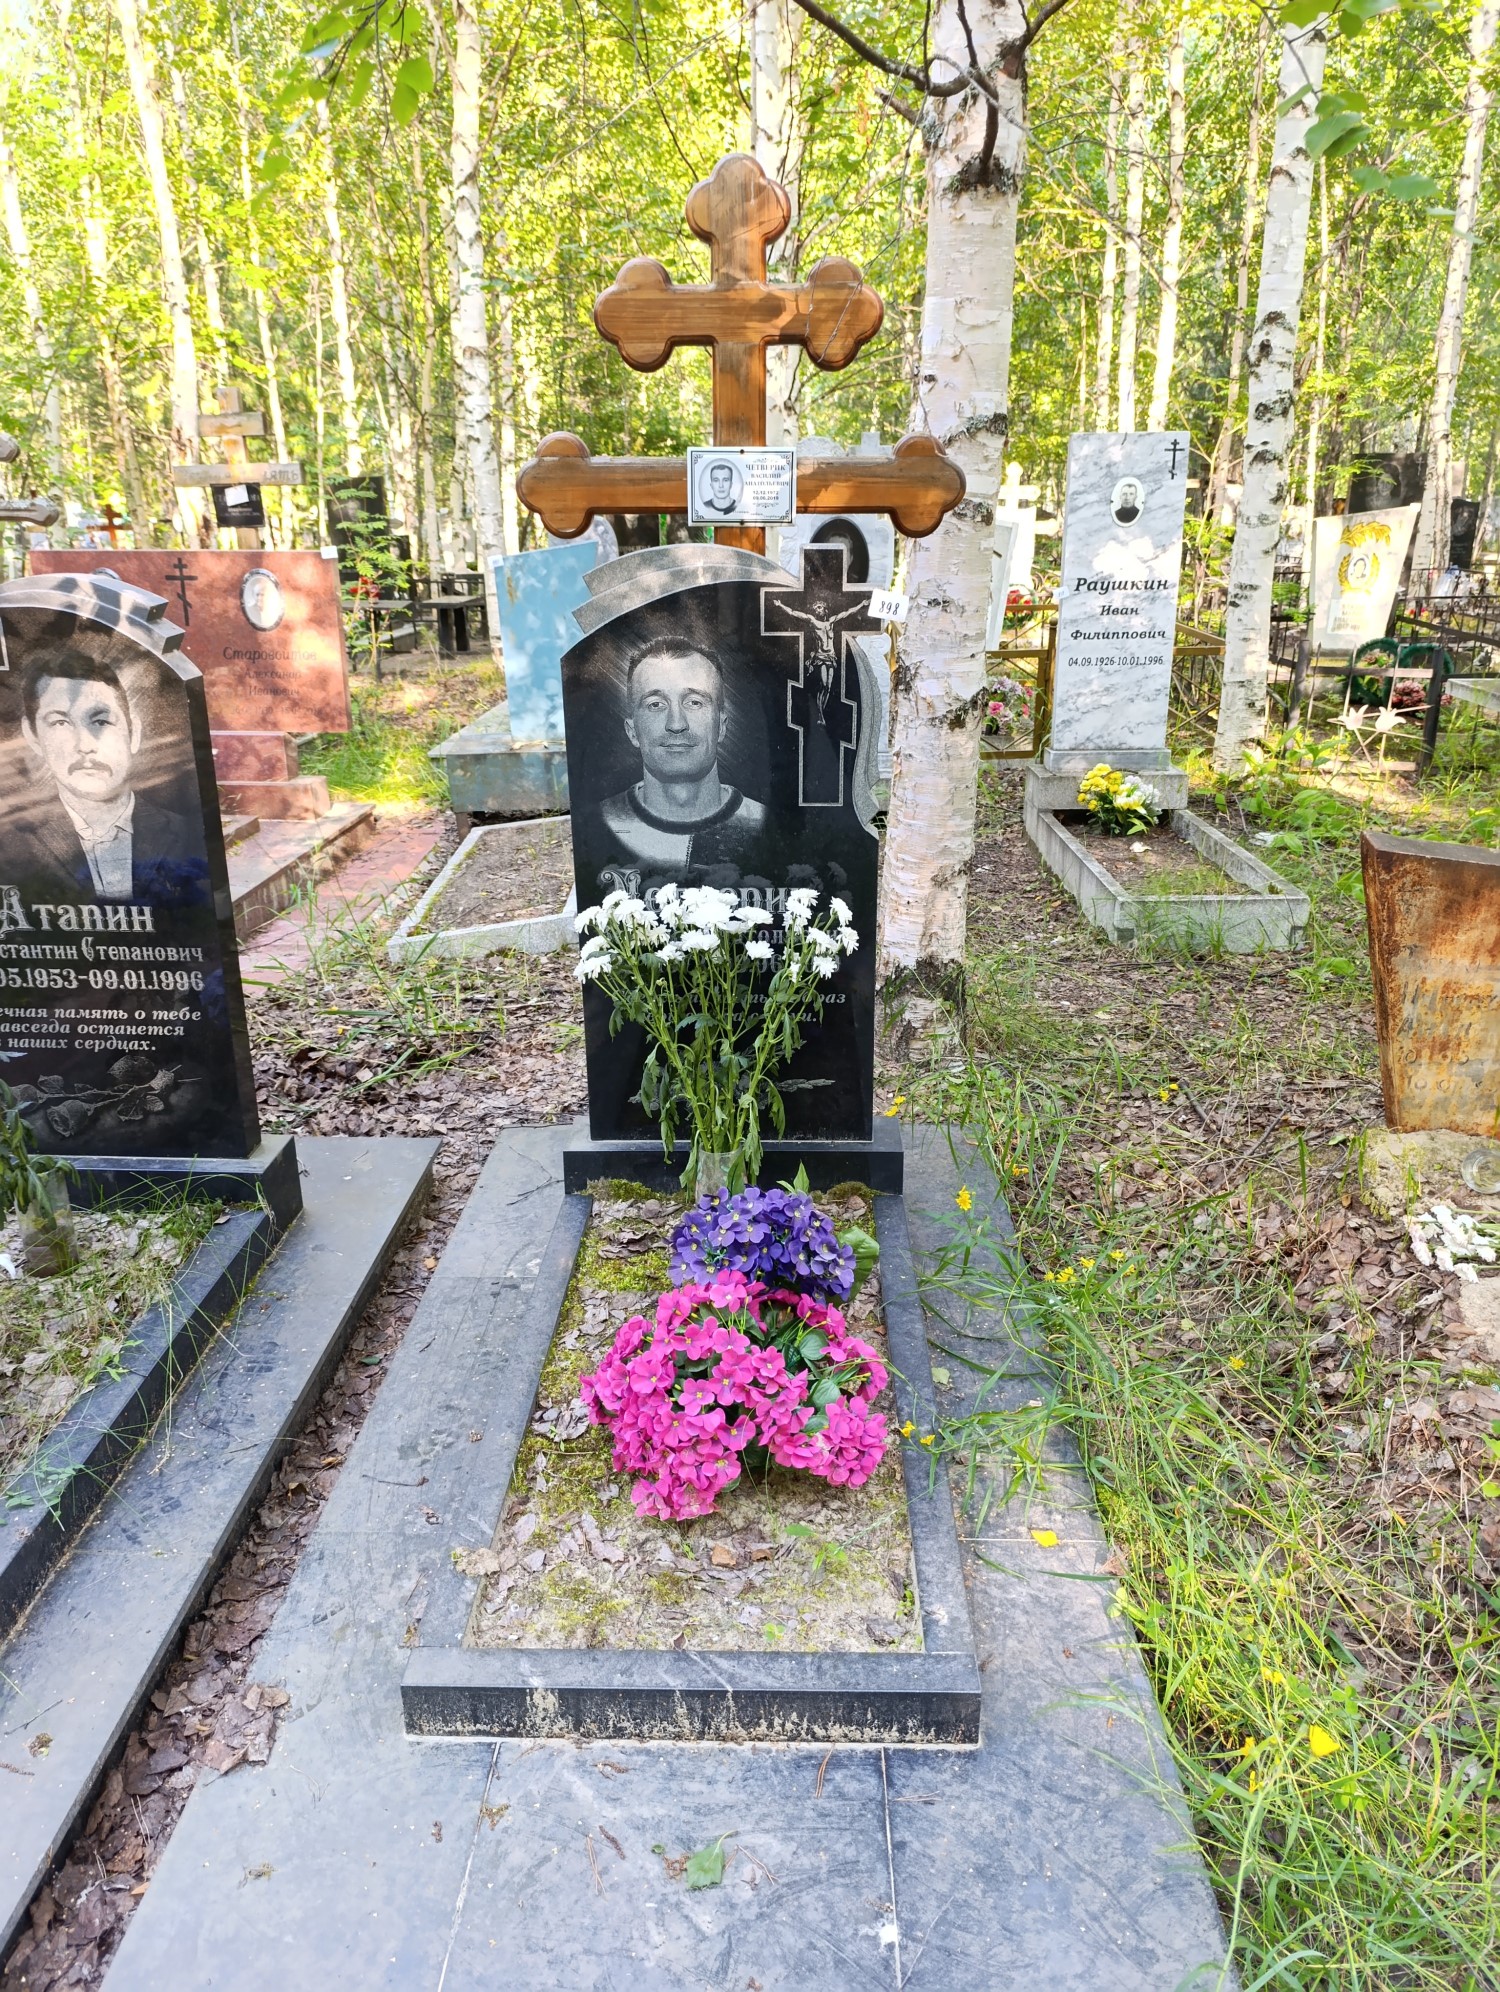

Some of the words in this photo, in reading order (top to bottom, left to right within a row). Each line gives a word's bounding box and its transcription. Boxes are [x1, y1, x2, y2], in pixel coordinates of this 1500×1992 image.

[1074, 577, 1169, 596] Раушкин
[879, 600, 900, 616] 898
[1100, 605, 1140, 616] Иван
[1070, 629, 1167, 641] Филиппович
[1068, 655, 1164, 667] 04.09.1926-10.01.1996
[81, 936, 204, 962] Степанович
[54, 1008, 128, 1020] память
[134, 1009, 146, 1020] о
[152, 1006, 201, 1021] тебе
[77, 1023, 185, 1036] останется
[8, 1037, 68, 1049] наших
[75, 1035, 156, 1053] сердцах.
